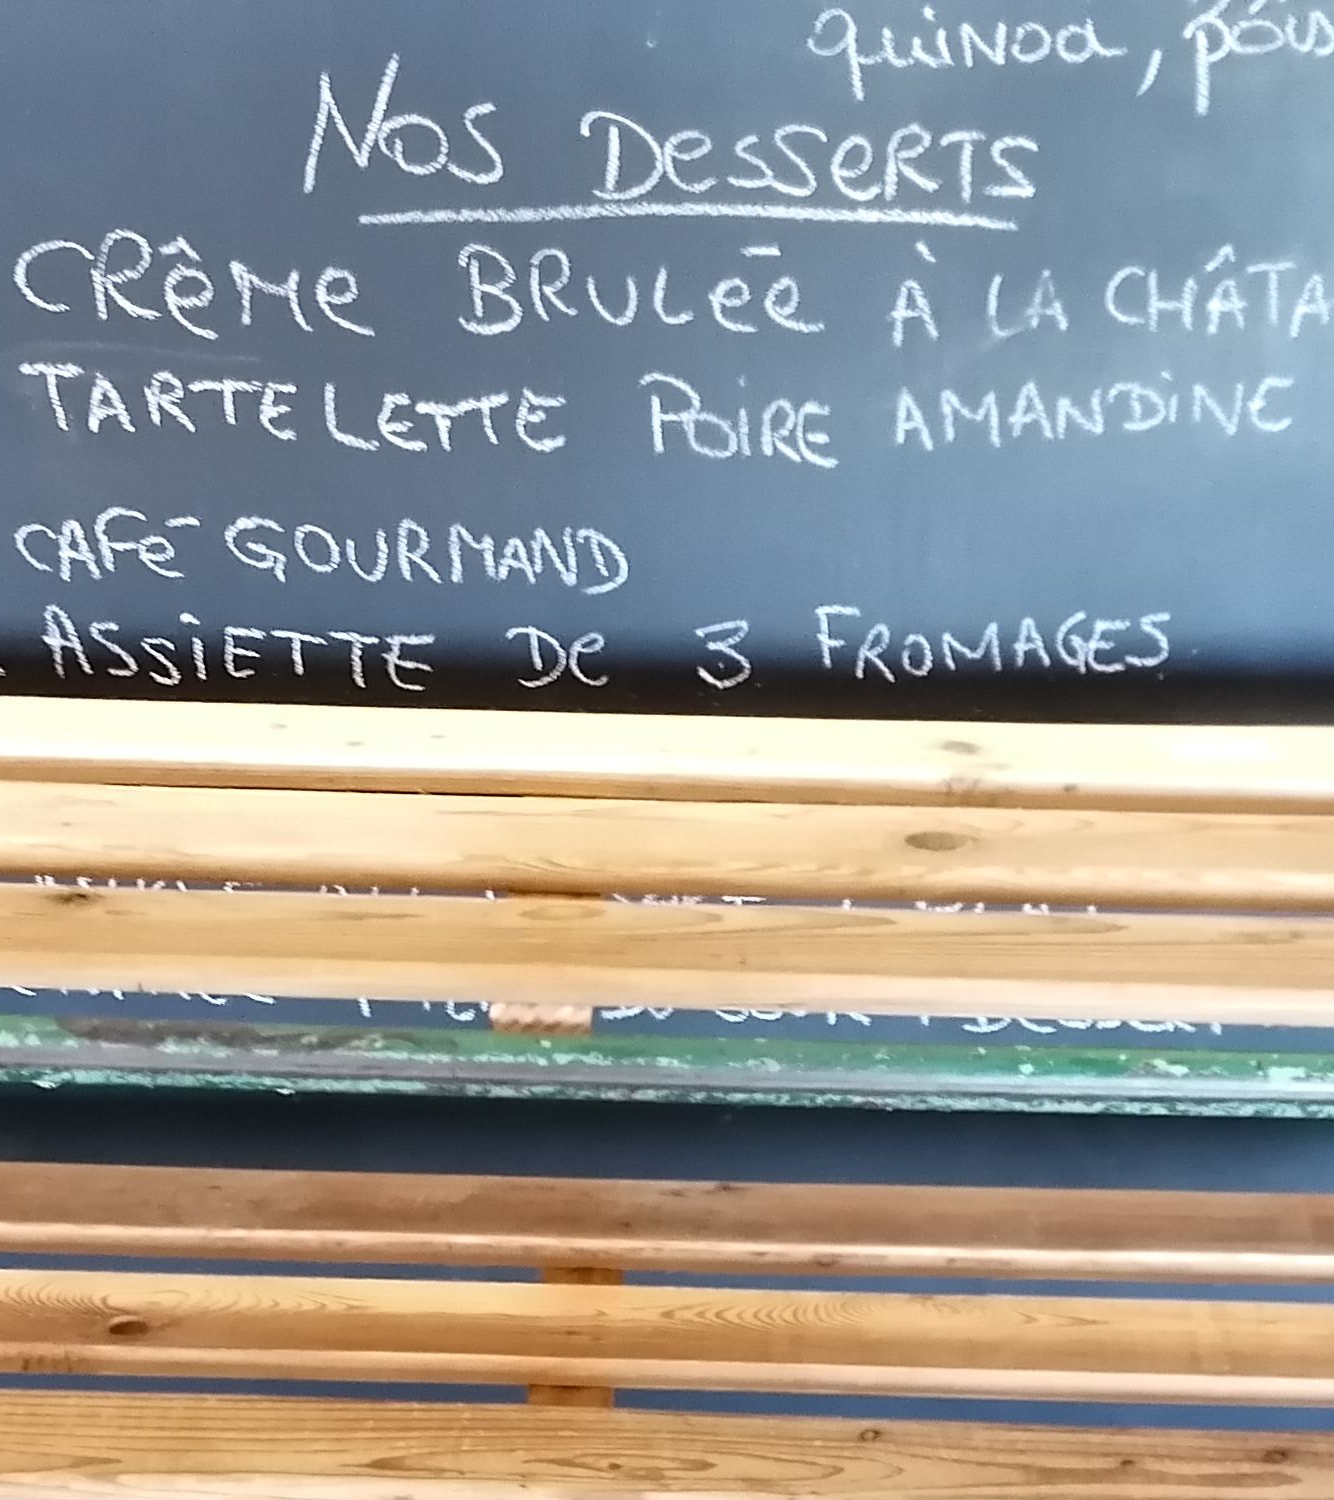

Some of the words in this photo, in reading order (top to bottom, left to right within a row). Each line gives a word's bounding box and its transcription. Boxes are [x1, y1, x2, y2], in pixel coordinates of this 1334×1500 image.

[890, 241, 939, 347] À
[987, 269, 1068, 338] LA
[18, 362, 567, 453] TARTELETTE
[224, 515, 630, 595] GOURMAND
[695, 620, 753, 690] 3
